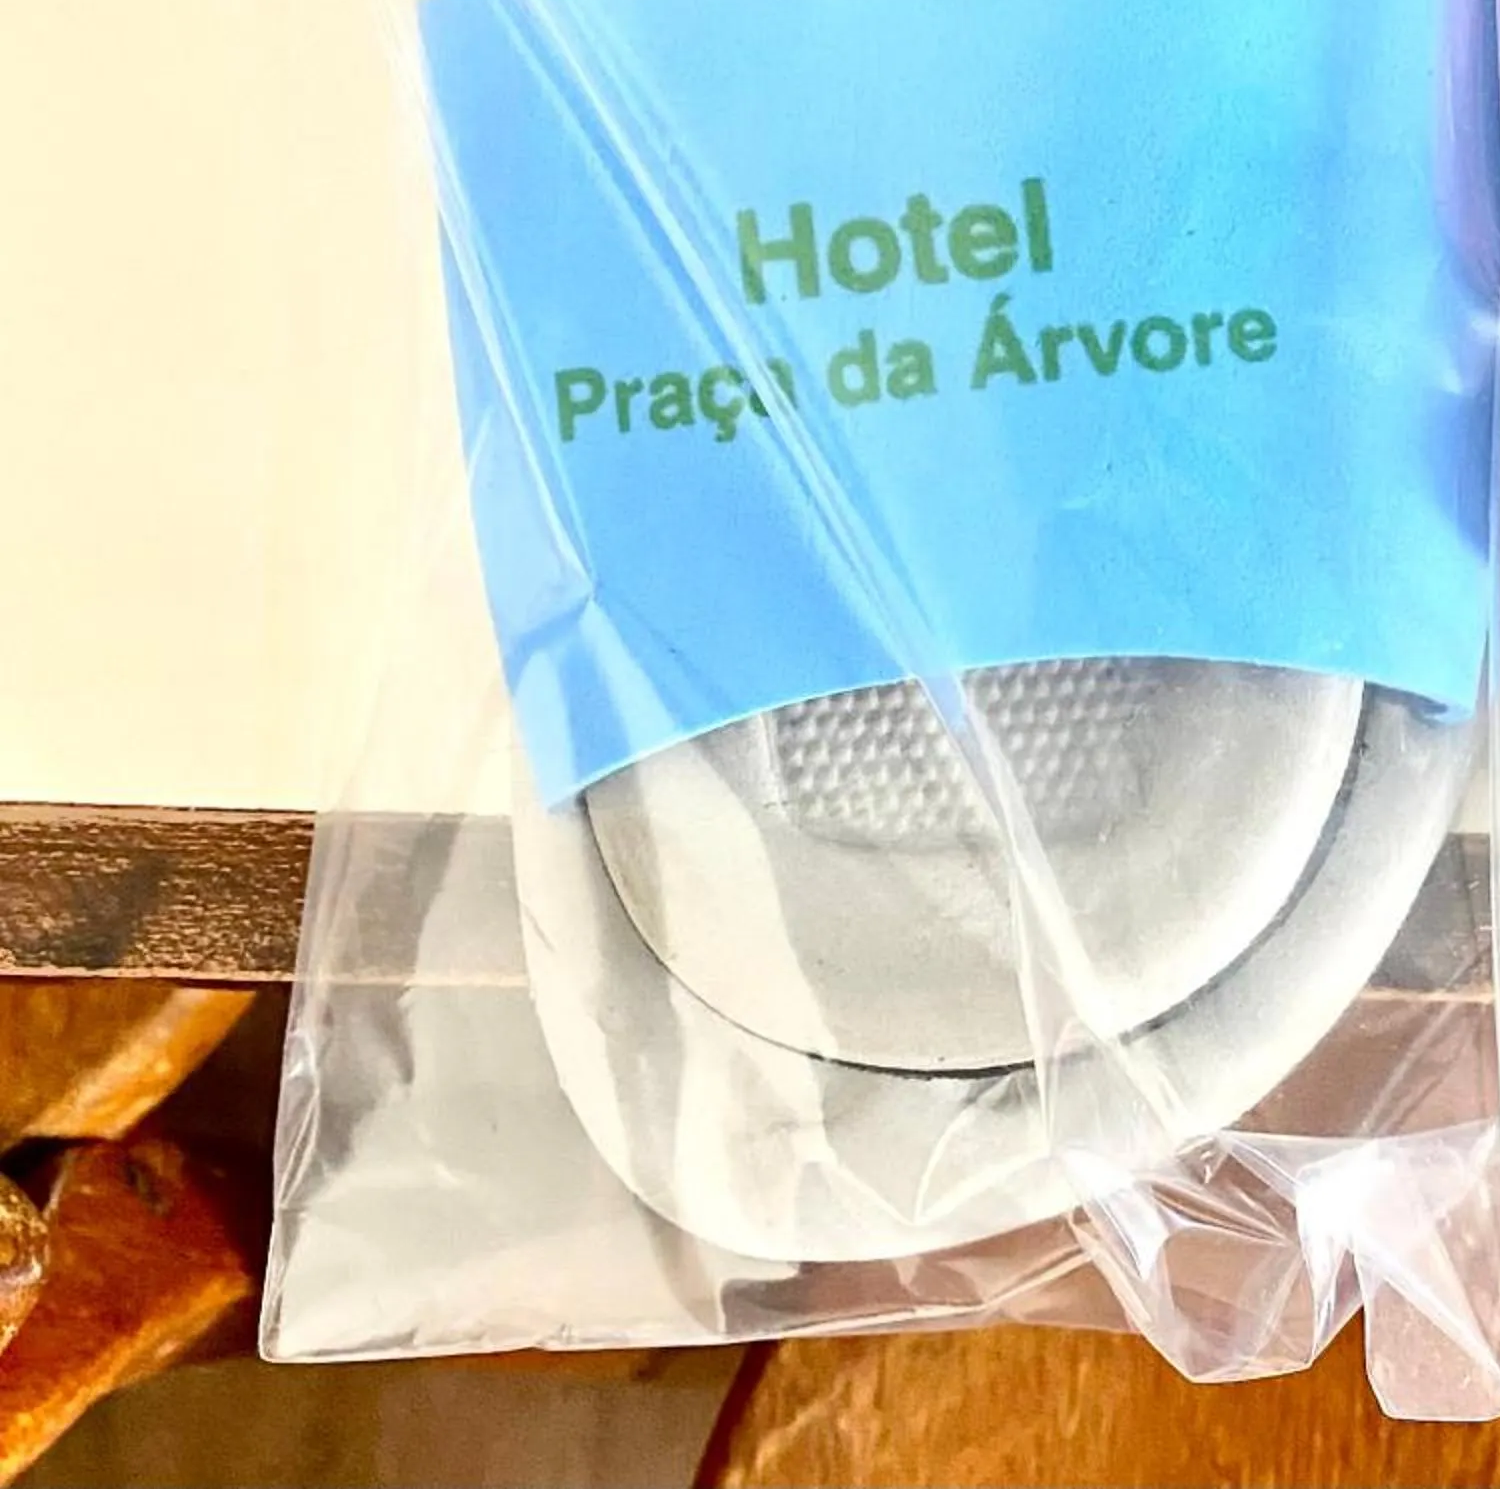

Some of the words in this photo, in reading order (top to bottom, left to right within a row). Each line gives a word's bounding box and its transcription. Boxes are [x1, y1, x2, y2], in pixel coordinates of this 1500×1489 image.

[735, 176, 1054, 305] Hotel
[826, 328, 939, 408] da
[969, 292, 1279, 391] Árvore
